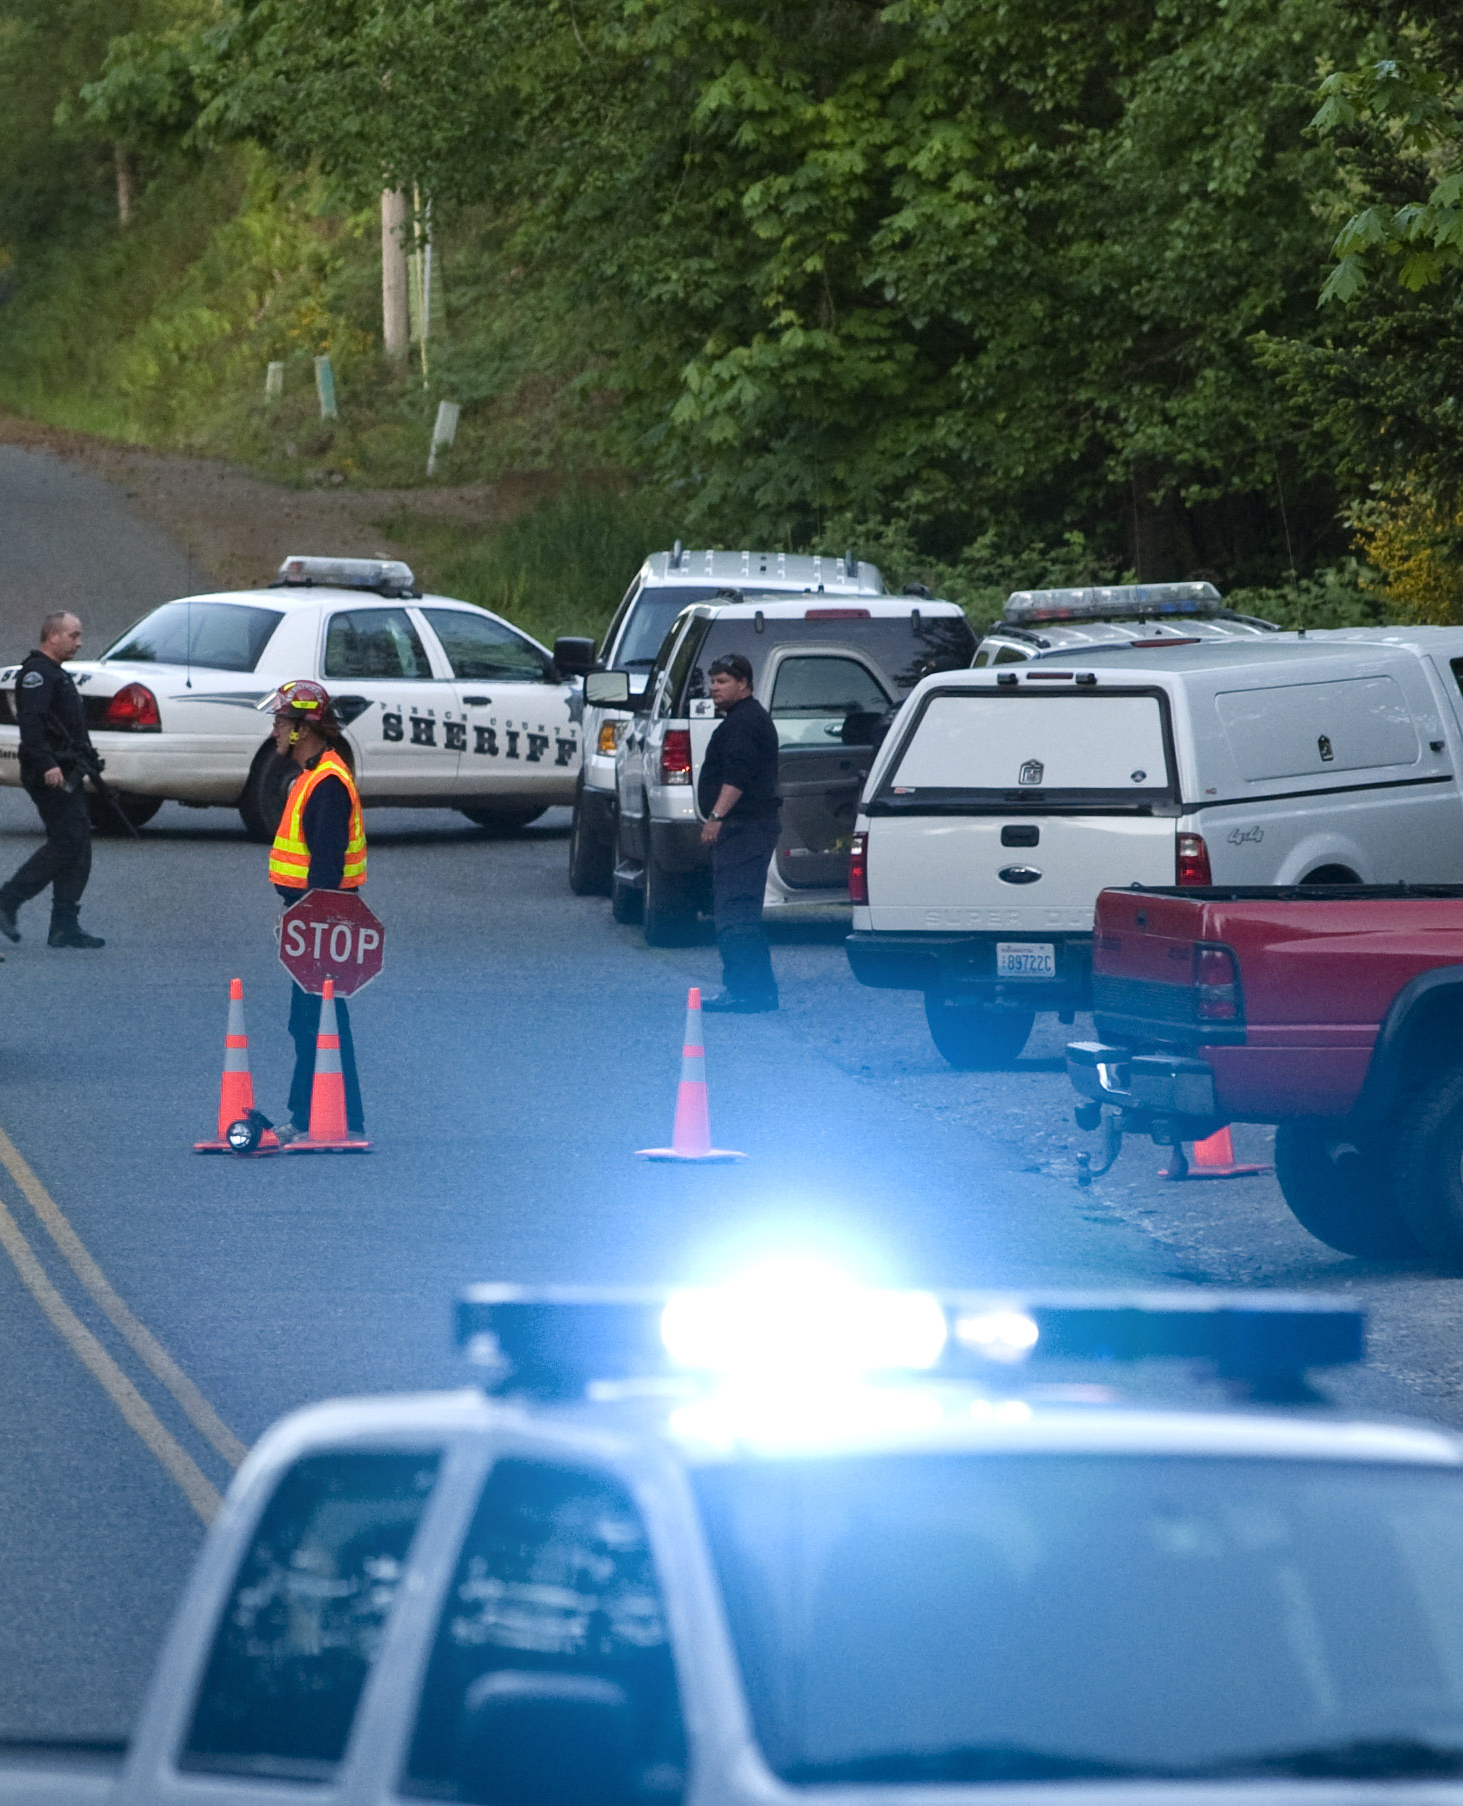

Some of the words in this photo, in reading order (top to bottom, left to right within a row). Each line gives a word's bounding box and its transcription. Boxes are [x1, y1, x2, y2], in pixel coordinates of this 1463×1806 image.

[489, 717, 577, 738] COUNTY
[382, 712, 577, 767] SHERIFF
[1227, 825, 1265, 846] 4x4
[285, 919, 380, 965] STOP
[1007, 954, 1052, 972] 89722C
